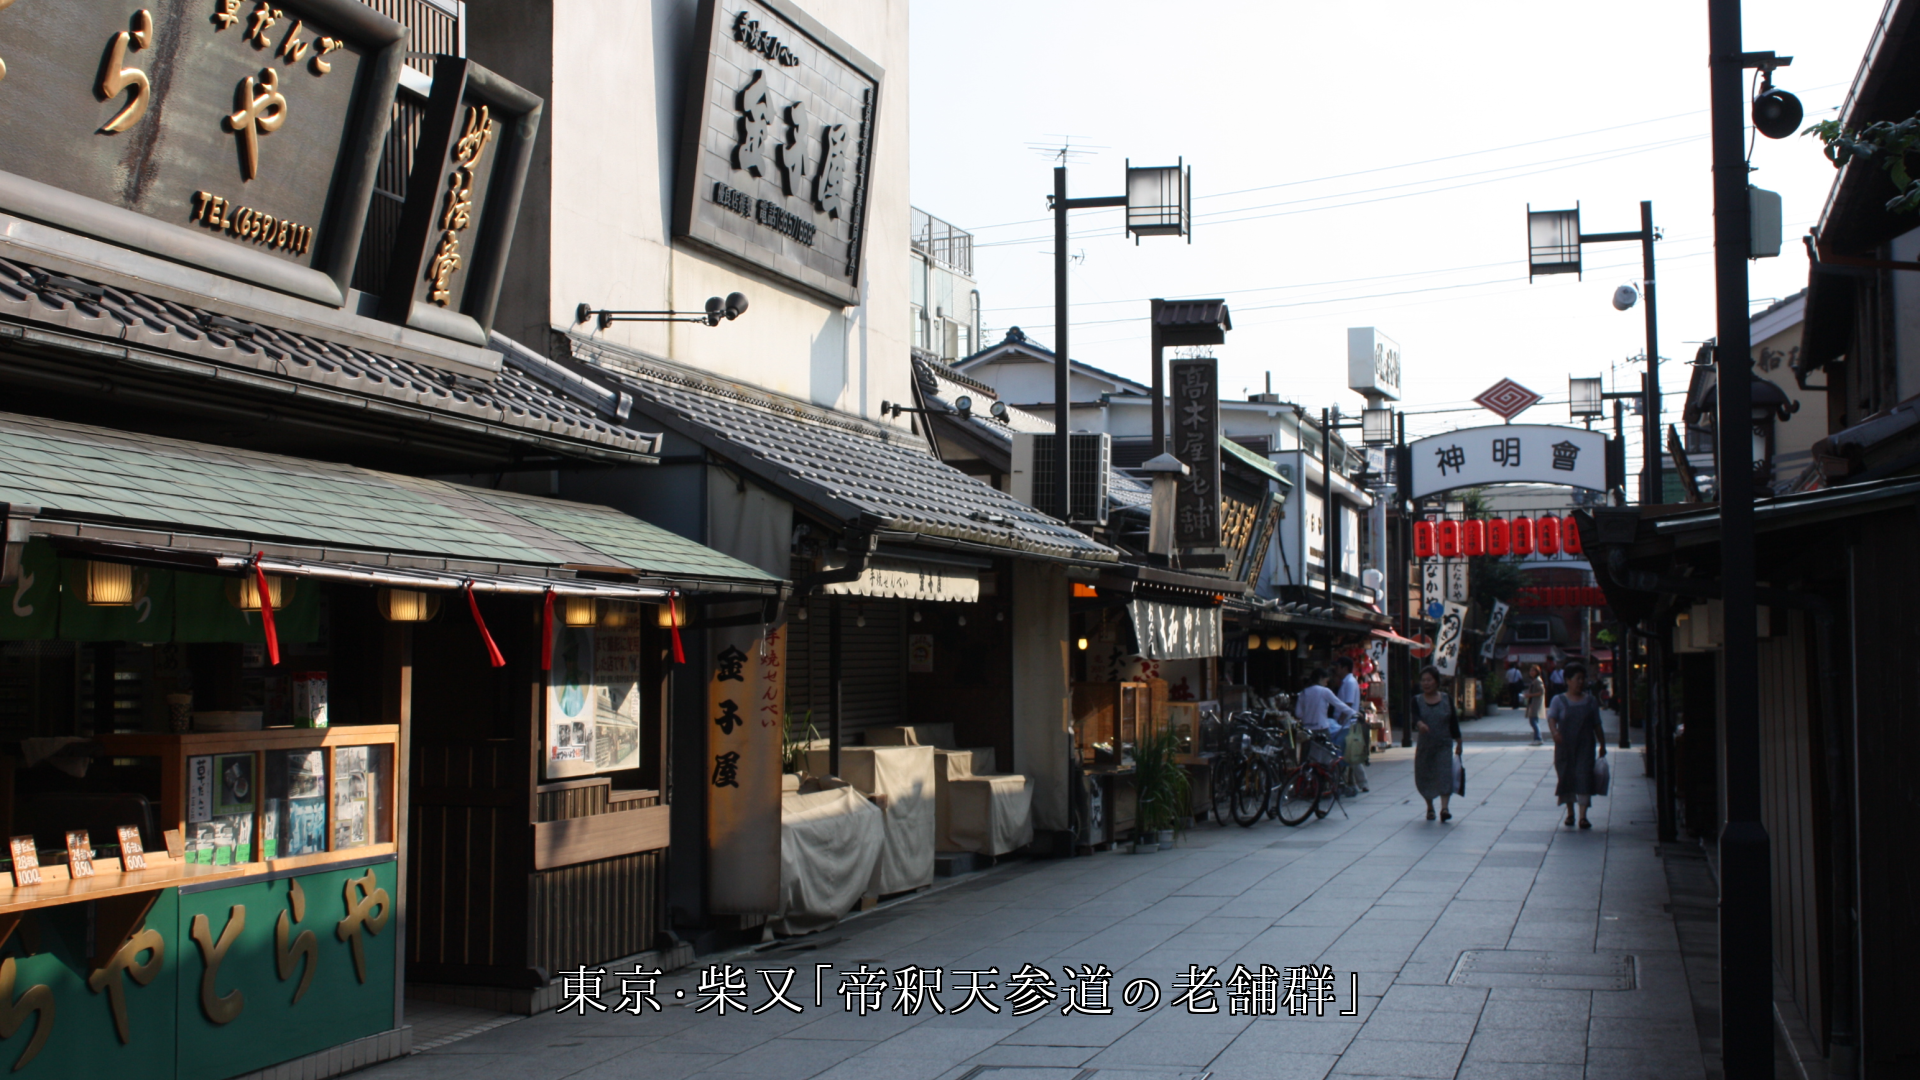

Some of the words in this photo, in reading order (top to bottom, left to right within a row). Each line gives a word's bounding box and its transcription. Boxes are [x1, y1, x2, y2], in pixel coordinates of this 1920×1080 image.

[198, 191, 230, 229] TEL
[234, 206, 313, 254] (659)8111
[1435, 437, 1581, 476] 神明會
[711, 644, 749, 788] 金子屋
[760, 627, 780, 728] 手焼せんべい
[190, 868, 391, 1025] とらや
